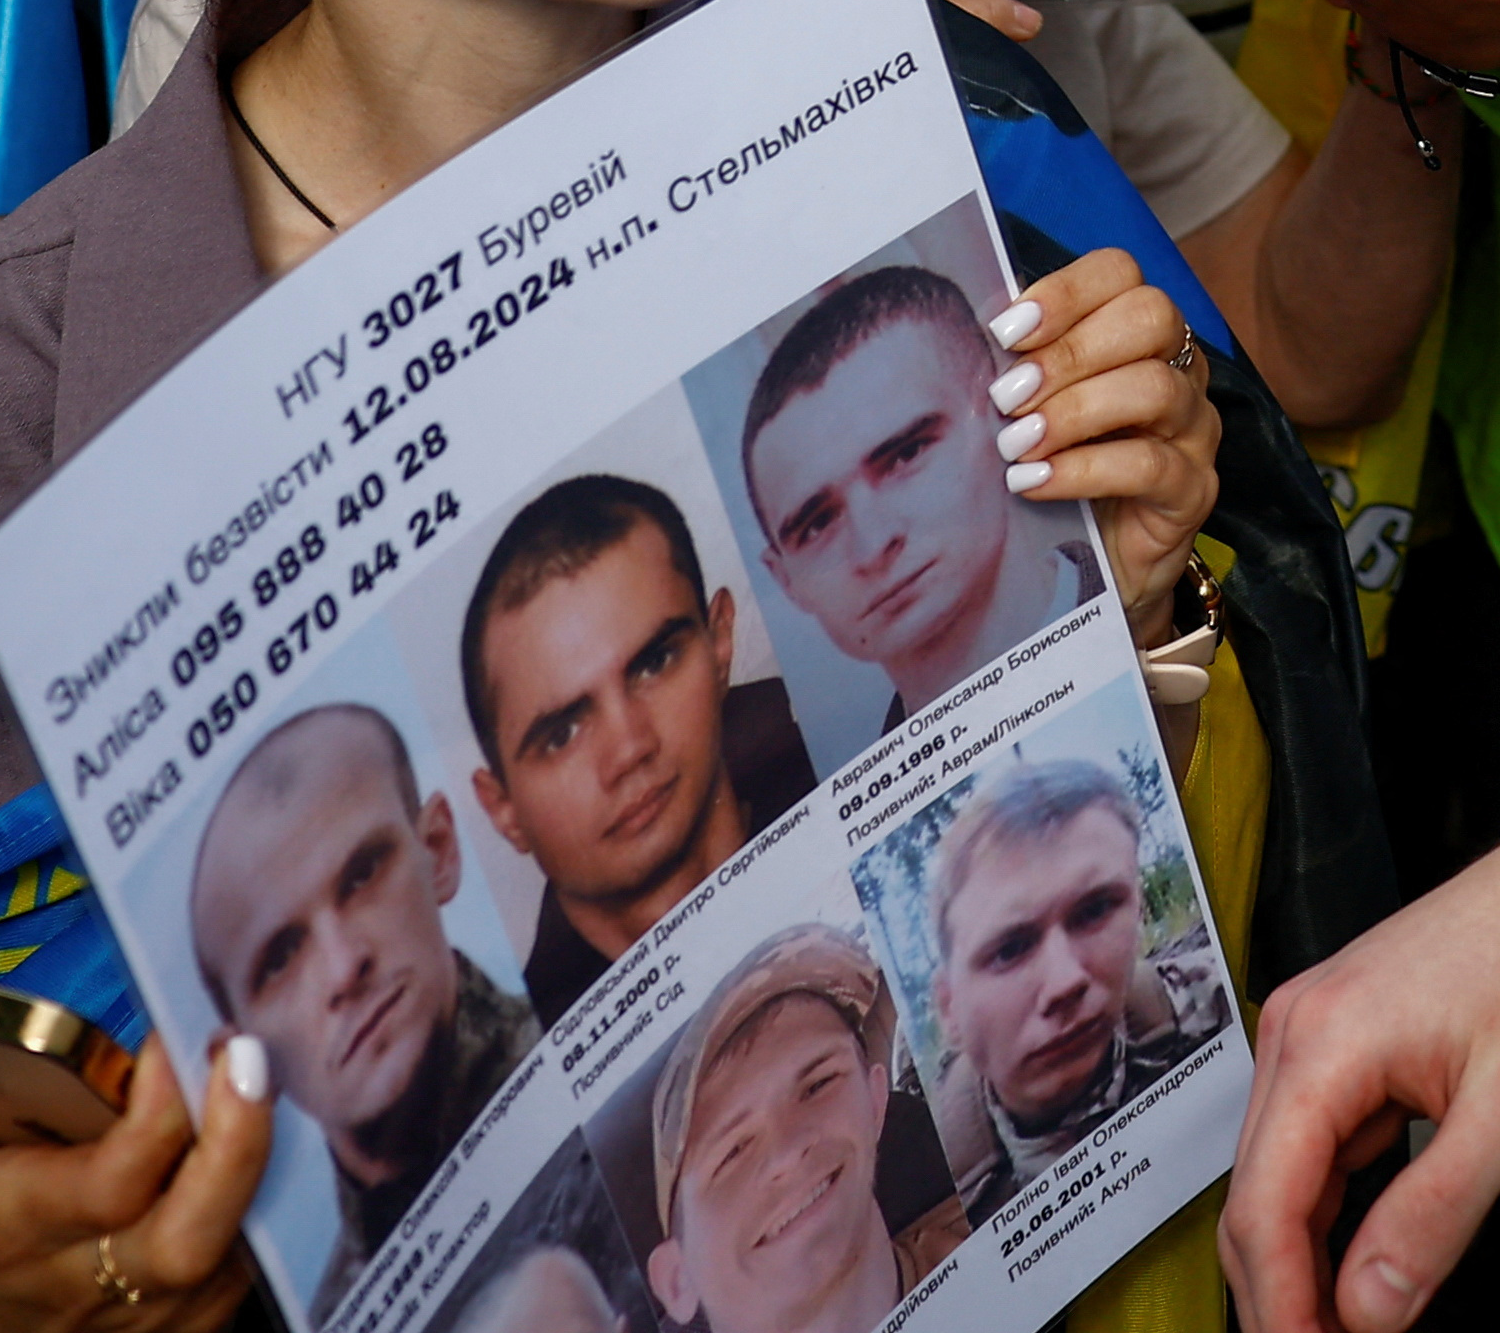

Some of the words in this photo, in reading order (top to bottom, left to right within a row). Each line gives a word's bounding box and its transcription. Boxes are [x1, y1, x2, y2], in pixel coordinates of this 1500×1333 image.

[275, 333, 351, 418] НГУ
[362, 252, 464, 349] 3027
[477, 150, 627, 267] Буревій
[44, 581, 181, 725] Зникли
[184, 440, 334, 586] безвісти
[342, 256, 575, 443] 12.08.2024
[585, 218, 659, 270] н.п.
[667, 49, 919, 214] Стельмахівка
[73, 687, 167, 799] Аліса
[172, 600, 245, 687] 095
[252, 525, 327, 607] 888
[337, 473, 386, 529] 40
[395, 422, 449, 482] 28
[104, 758, 182, 850] Віка
[186, 672, 258, 760] 050
[266, 594, 340, 676] 670
[350, 541, 399, 597] 44
[408, 490, 461, 548] 24
[831, 735, 904, 797] Аврамич
[908, 664, 1004, 738] Олександр
[1007, 605, 1102, 671] Борисович
[838, 734, 946, 822] 09.09.1996
[950, 724, 968, 745] р.
[846, 773, 937, 847] Позивний:
[941, 679, 1075, 778] Аврам/Лінкольн
[653, 886, 715, 950] Дмитро
[717, 805, 810, 886] Сергійович
[562, 967, 660, 1073] 08.11.2000
[665, 952, 681, 974] р.
[572, 1010, 654, 1100] Позивний:
[460, 1054, 544, 1160] Вікторович
[991, 1180, 1050, 1233] Поліно
[1054, 1147, 1089, 1182] Іван
[1092, 1040, 1224, 1148] Олександрович
[1000, 1162, 1106, 1260] 29.06.2001
[1110, 1148, 1129, 1169] р.
[1007, 1201, 1097, 1283] Позивний:
[1100, 1156, 1152, 1207] Акула
